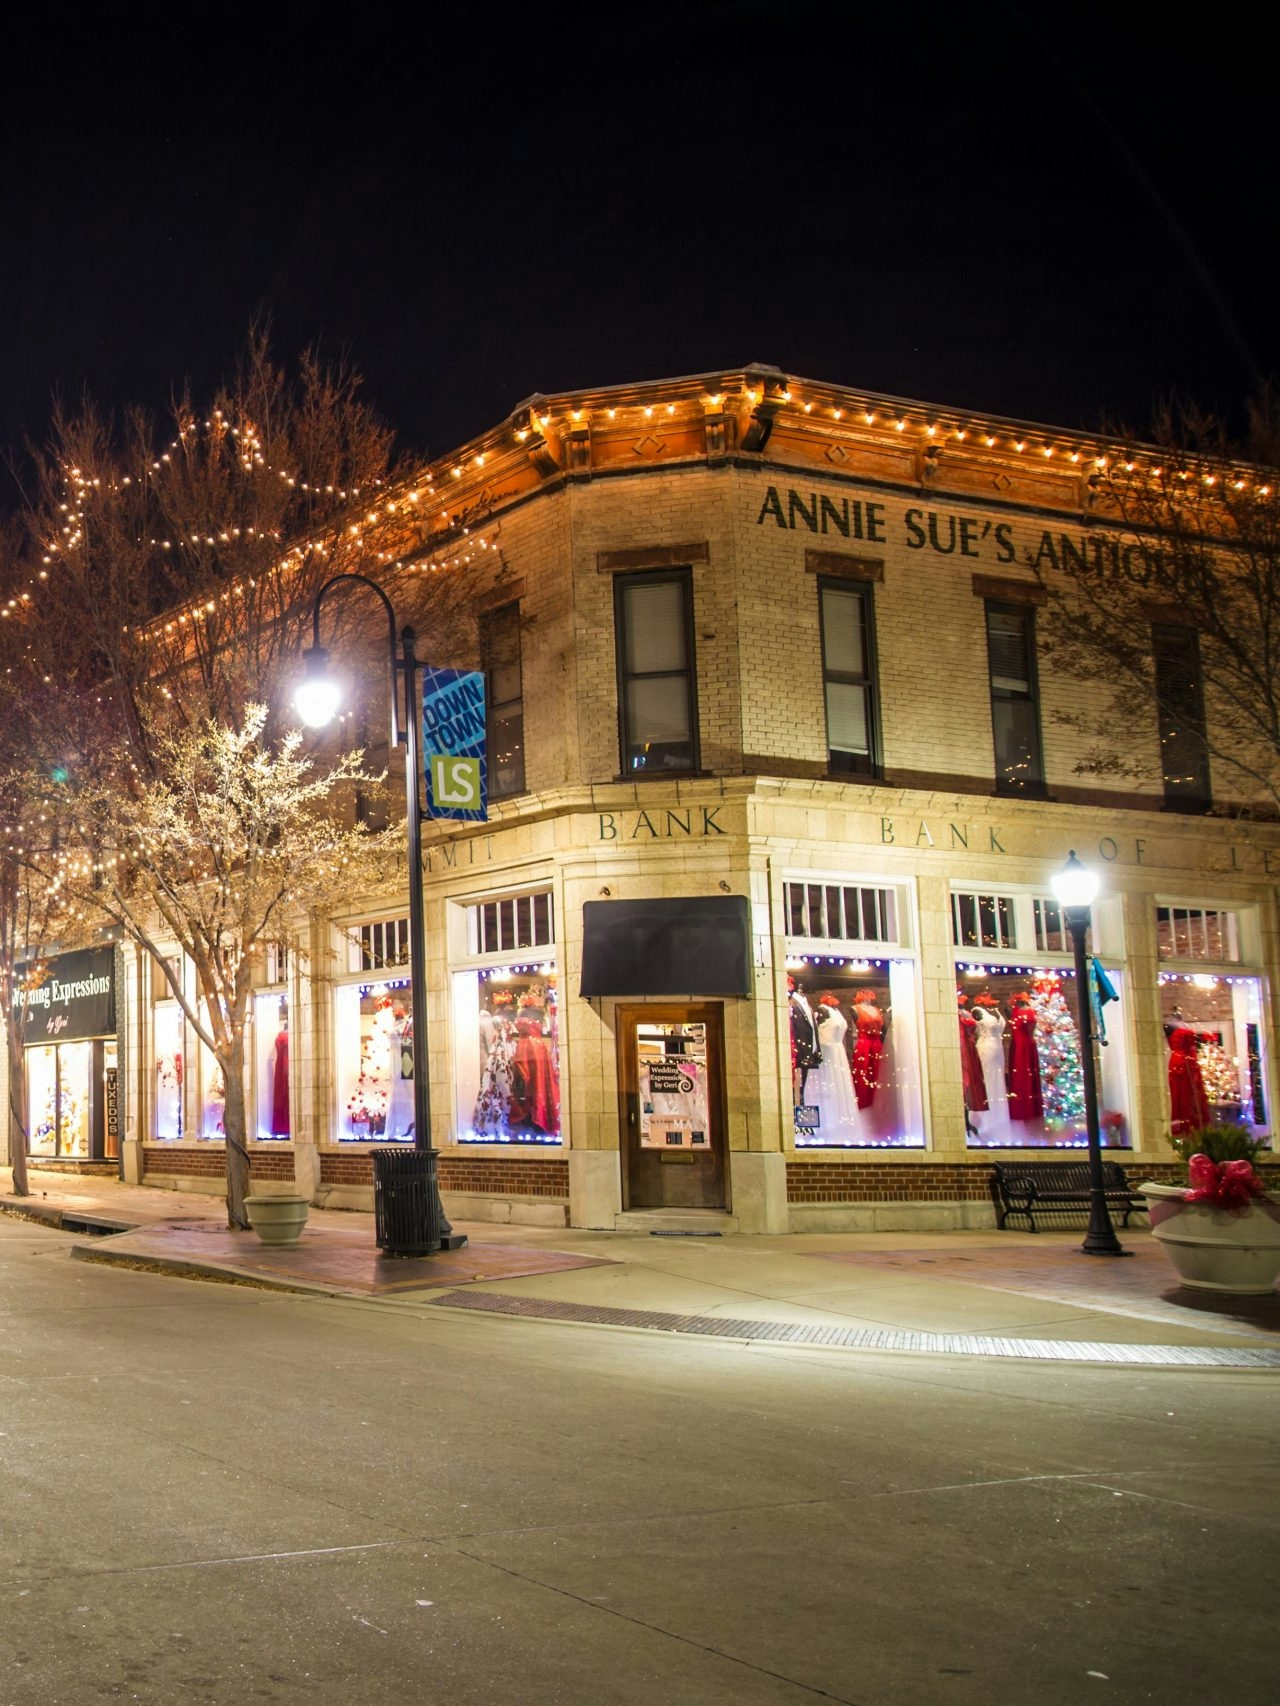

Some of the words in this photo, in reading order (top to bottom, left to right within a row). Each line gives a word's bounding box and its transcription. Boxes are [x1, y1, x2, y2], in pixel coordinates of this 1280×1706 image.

[757, 486, 886, 543] ANNIE
[905, 508, 1016, 563] SUE'S
[423, 680, 483, 730] DOWN
[425, 707, 486, 754] TOWN
[437, 761, 474, 803] LS
[599, 807, 728, 841] BANK
[880, 817, 1006, 853] BANK
[1099, 837, 1146, 864] OF
[51, 973, 110, 1005] Expressions
[46, 1017, 54, 1034] by
[651, 1066, 679, 1074] Wedding
[654, 1081, 663, 1089] by
[108, 1073, 118, 1133] TUXEDOS
